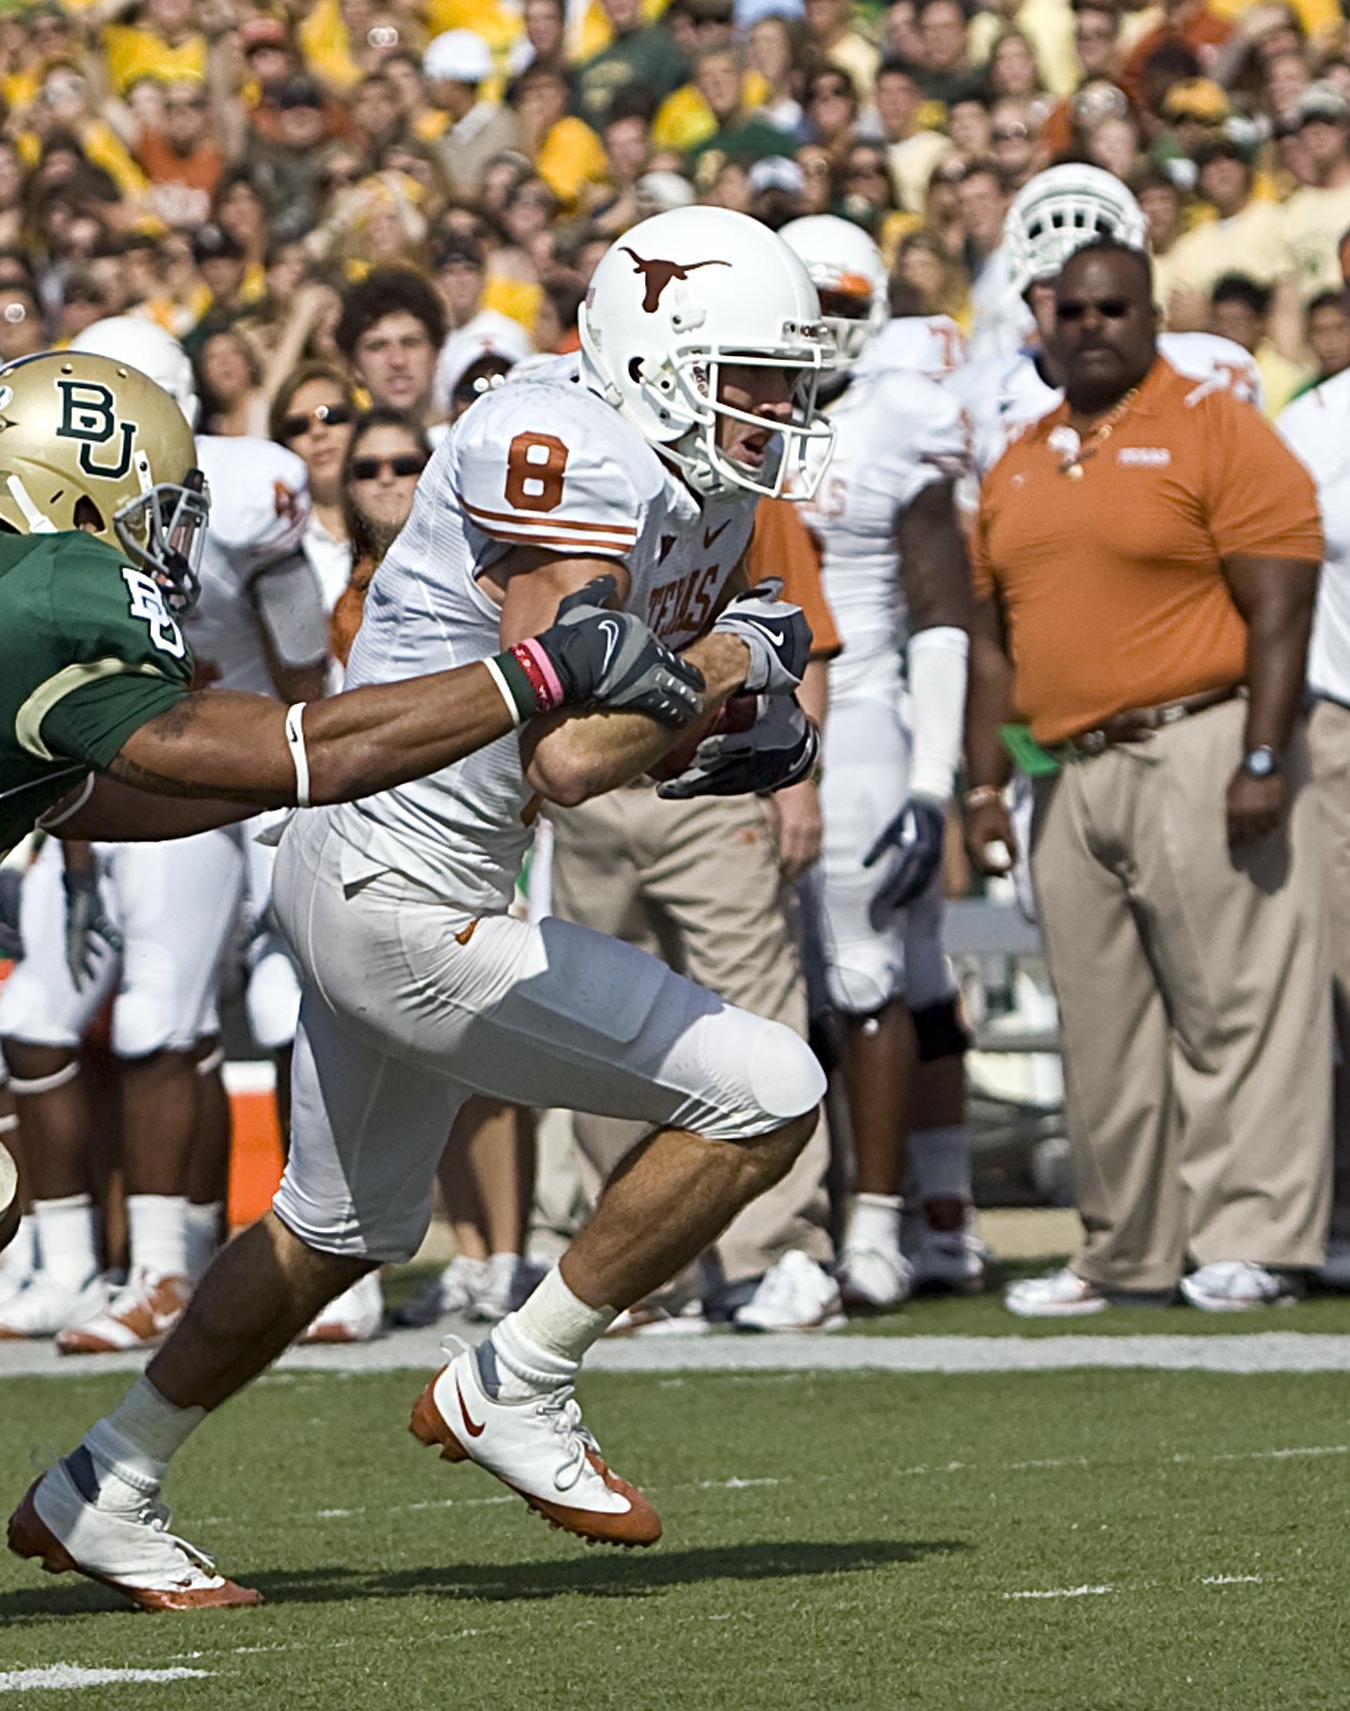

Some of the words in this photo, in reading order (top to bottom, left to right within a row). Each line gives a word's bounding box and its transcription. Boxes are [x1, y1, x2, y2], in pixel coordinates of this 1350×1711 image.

[54, 378, 138, 482] BU
[504, 430, 569, 513] 8
[122, 567, 186, 659] BU
[647, 564, 720, 638] TEXAS
